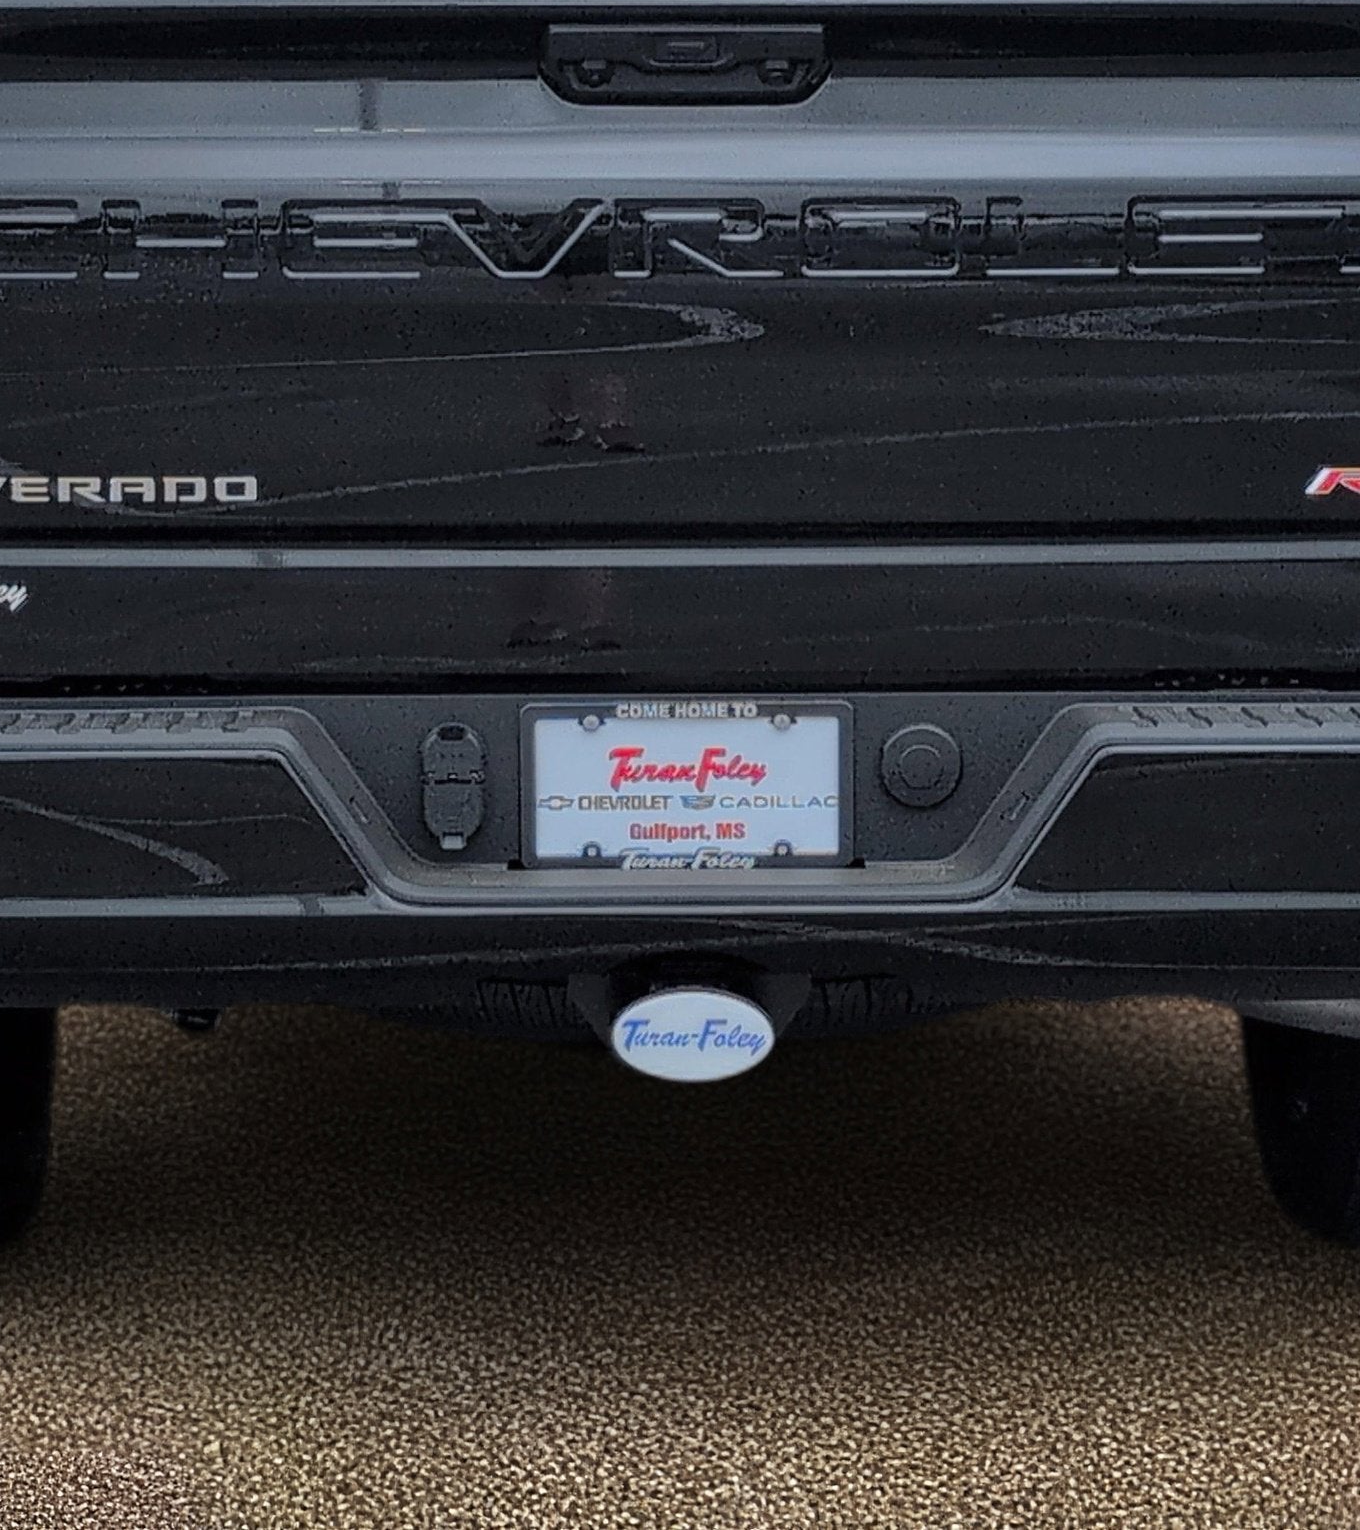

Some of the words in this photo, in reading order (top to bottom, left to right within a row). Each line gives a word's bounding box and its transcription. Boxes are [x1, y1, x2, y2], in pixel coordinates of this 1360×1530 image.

[616, 702, 671, 719] COME
[675, 702, 729, 719] HOME
[730, 702, 758, 719] TO
[578, 795, 673, 810] CHEVROLET
[720, 794, 839, 809] CADILLAC
[629, 822, 711, 843] Gulfport,
[715, 822, 746, 840] MS
